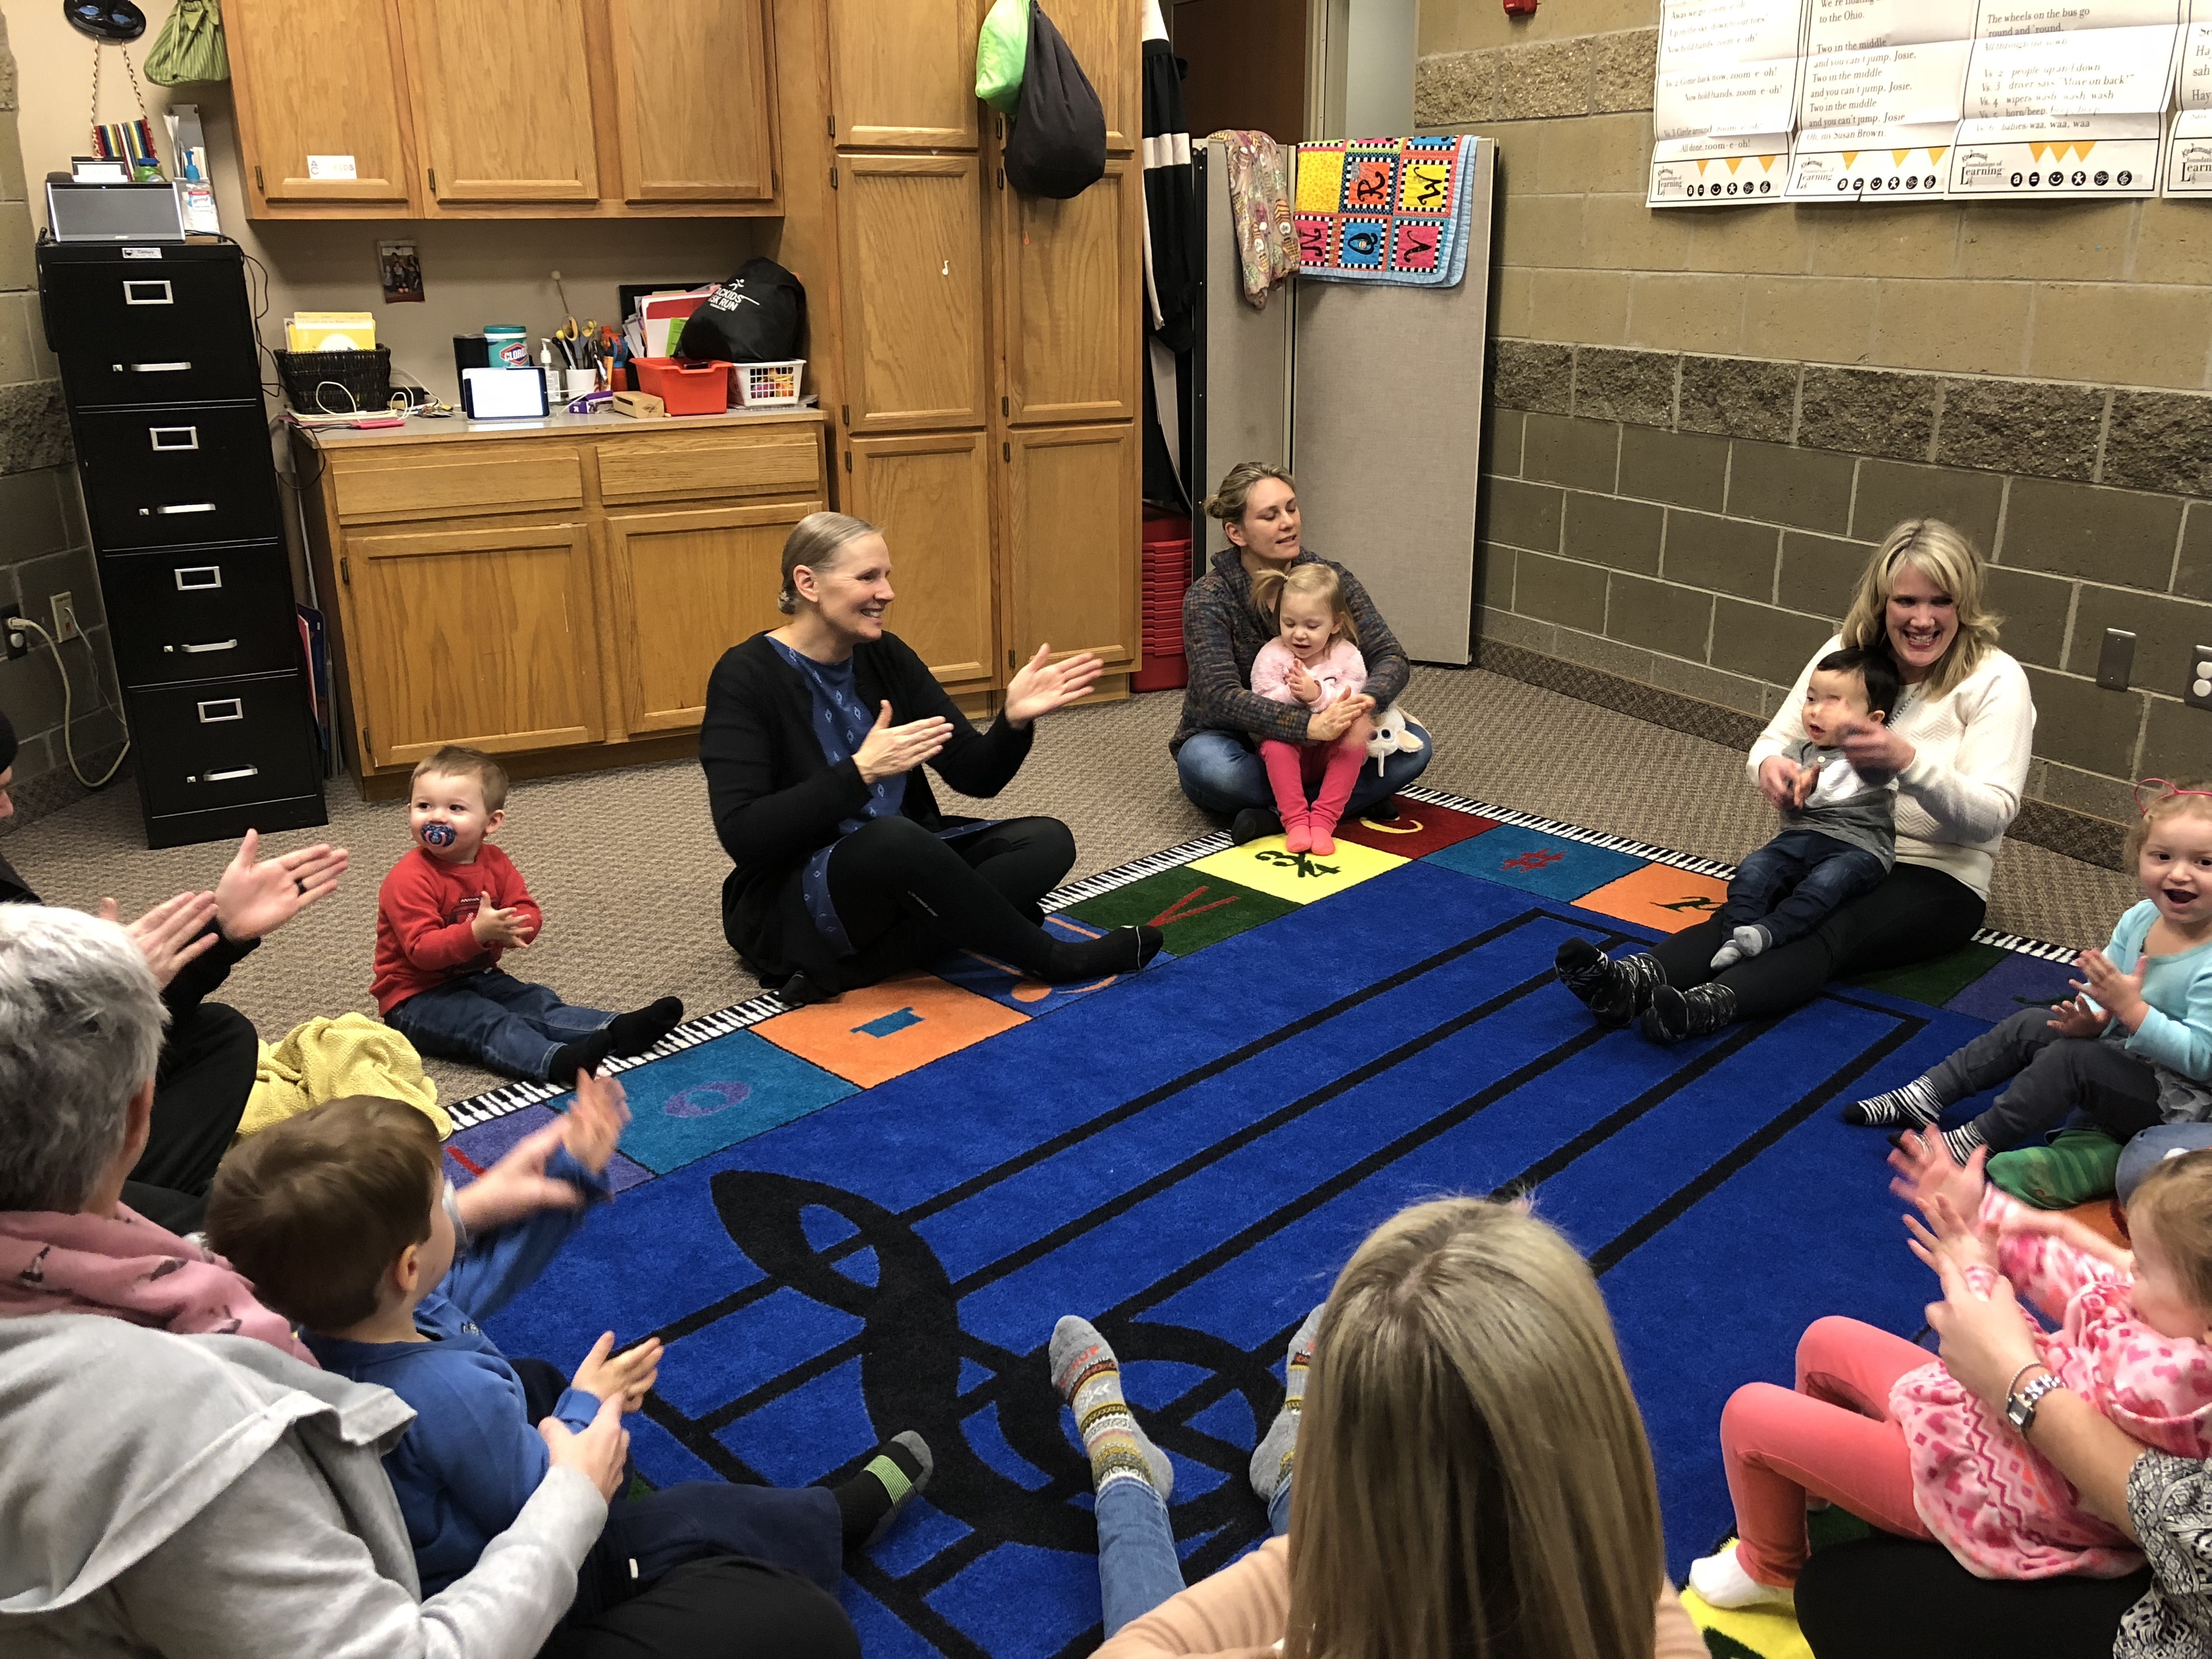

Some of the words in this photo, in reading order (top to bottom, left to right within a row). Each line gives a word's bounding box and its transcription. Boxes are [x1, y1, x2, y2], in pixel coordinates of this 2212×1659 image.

[1830, 13, 1842, 22] the
[1844, 10, 1865, 20] Ohio.
[1987, 14, 2002, 24] The
[2004, 12, 2032, 22] wheels
[2046, 8, 2060, 19] the
[2062, 8, 2078, 18] bus
[2079, 8, 2090, 19] go
[2015, 25, 2030, 35] and
[1816, 44, 1832, 54] Two
[1835, 43, 1843, 52] in
[1846, 41, 1857, 50] the
[1859, 37, 1887, 49] middle
[1814, 58, 1829, 68] and
[2192, 64, 2210, 76] sah
[1812, 73, 1827, 83] Two
[1839, 71, 1852, 80] the
[1853, 67, 1882, 78] middle
[2011, 66, 2040, 78] people
[2044, 66, 2055, 75] up
[2076, 64, 2101, 72] down
[1680, 77, 1696, 86] Come
[1697, 75, 1710, 83] back
[1995, 81, 2001, 91] 3
[2008, 81, 2035, 90] driver
[1685, 93, 1696, 102] Now
[1697, 91, 1710, 99] hold
[1810, 88, 1824, 98] and
[1824, 88, 1839, 99] you
[1841, 84, 1860, 94] can't
[1979, 96, 1990, 106] Vs.
[1992, 98, 1999, 108] 4
[2006, 95, 2032, 106] wipers
[2091, 89, 2114, 99] wash
[2192, 88, 2211, 105] Hay
[1809, 103, 1824, 112] Two
[1825, 102, 1833, 111] in
[1835, 100, 1847, 110] the
[1849, 98, 1877, 109] middle
[1809, 117, 1822, 127] and
[1824, 117, 1836, 128] you
[1838, 114, 1856, 125] can't
[1677, 127, 1692, 136] Circle
[1692, 125, 1712, 134] around
[1833, 129, 1855, 139] Susan
[1960, 166, 2003, 185] Learning
[719, 298, 739, 312] RUN
